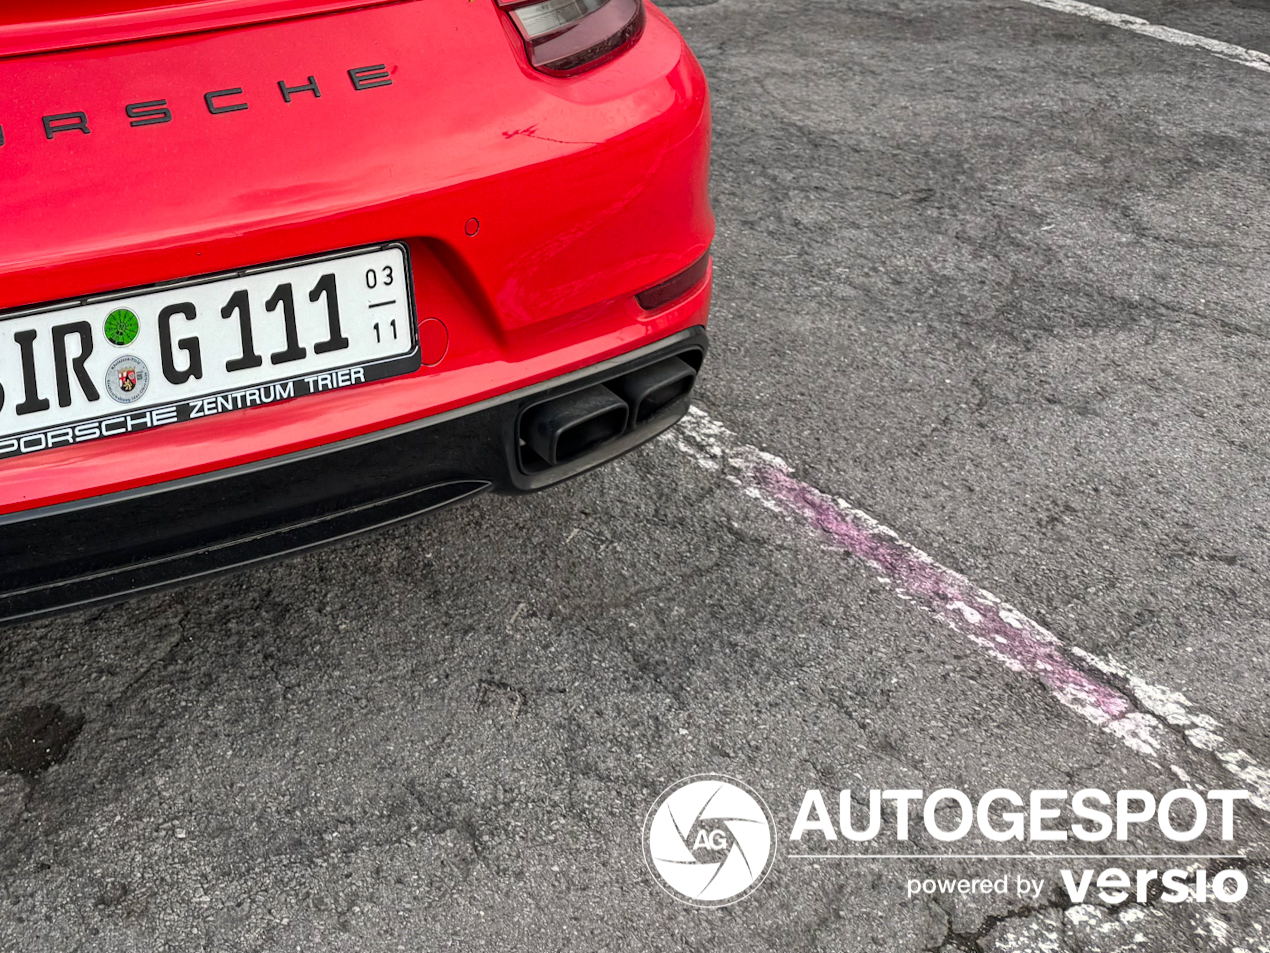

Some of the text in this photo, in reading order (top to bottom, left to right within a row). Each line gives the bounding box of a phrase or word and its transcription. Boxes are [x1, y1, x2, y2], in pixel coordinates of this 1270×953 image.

[365, 265, 394, 289] 03
[373, 319, 398, 343] 11
[189, 381, 295, 419] ZENTRUM
[304, 367, 366, 395] TRIER
